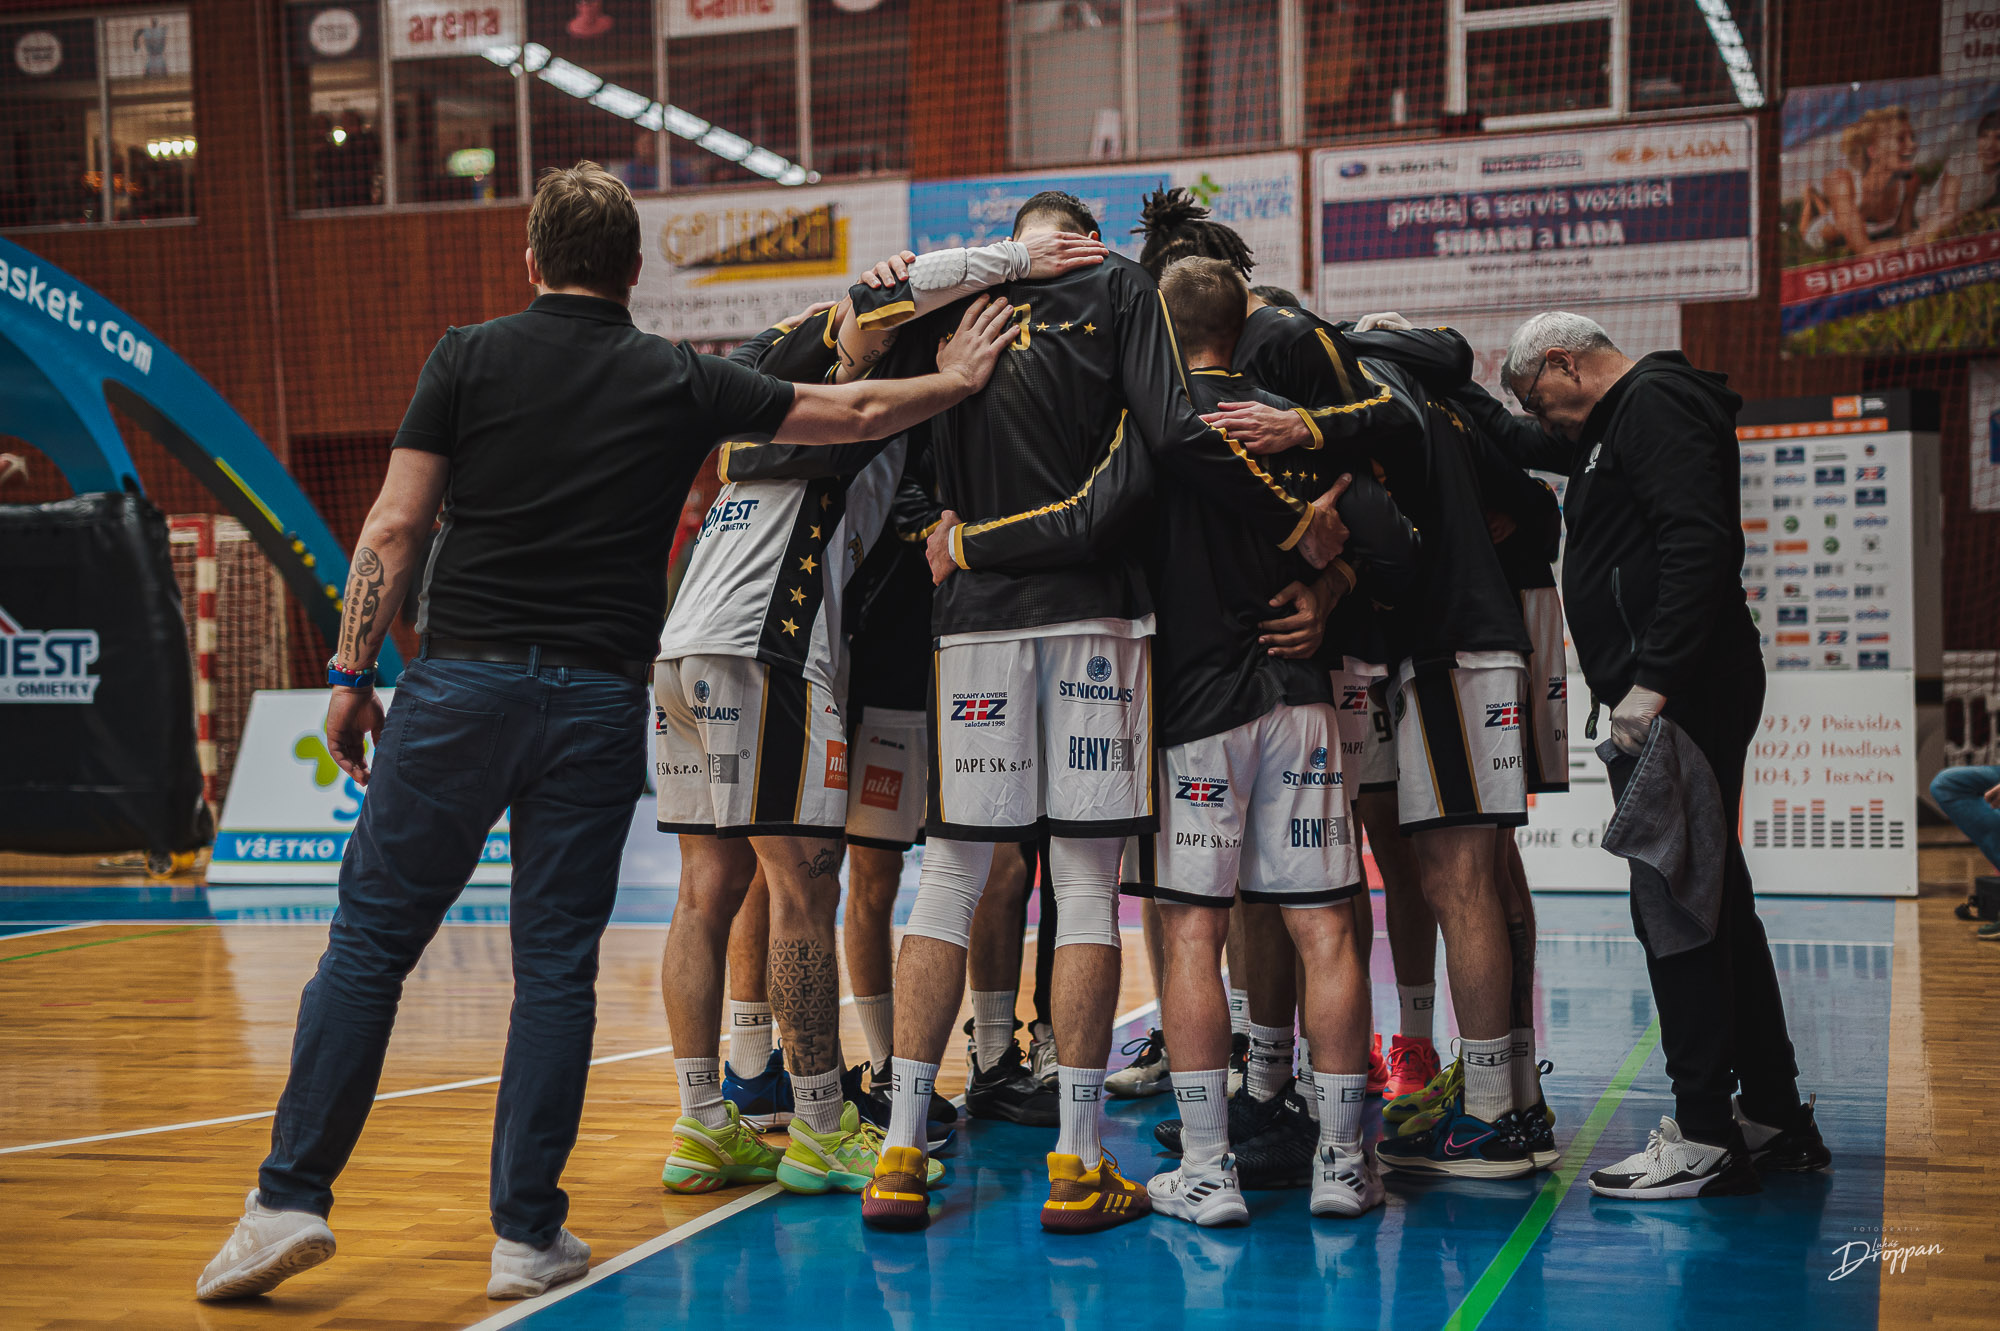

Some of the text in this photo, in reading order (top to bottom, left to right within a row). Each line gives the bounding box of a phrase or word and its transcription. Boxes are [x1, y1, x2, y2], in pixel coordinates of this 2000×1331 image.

[407, 7, 500, 43] arena
[1668, 140, 1731, 160] LADA
[1471, 196, 1491, 220] a
[1494, 189, 1570, 218] servis
[1575, 178, 1674, 213] vozidiel
[1536, 227, 1555, 249] a
[1560, 219, 1625, 247] LADA
[16, 682, 90, 697] OMIETKY
[952, 692, 980, 700] PODLAHY
[986, 691, 1008, 699] DVERE
[1485, 702, 1512, 710] PODLAHY
[1763, 714, 1811, 734] 93,9
[1068, 735, 1123, 772] BENY stav
[1754, 740, 1811, 761] 102,0
[673, 763, 702, 775] s.r.o.
[955, 757, 1034, 773] DAPE SK s.r.o.
[1493, 755, 1522, 771] DAPE
[1208, 777, 1230, 785] DVERE
[1754, 767, 1811, 787] 104,3
[1176, 832, 1208, 848] DAPE
[1210, 834, 1223, 849] SK
[1328, 818, 1339, 846] stav
[234, 834, 336, 861] VŠETKO
